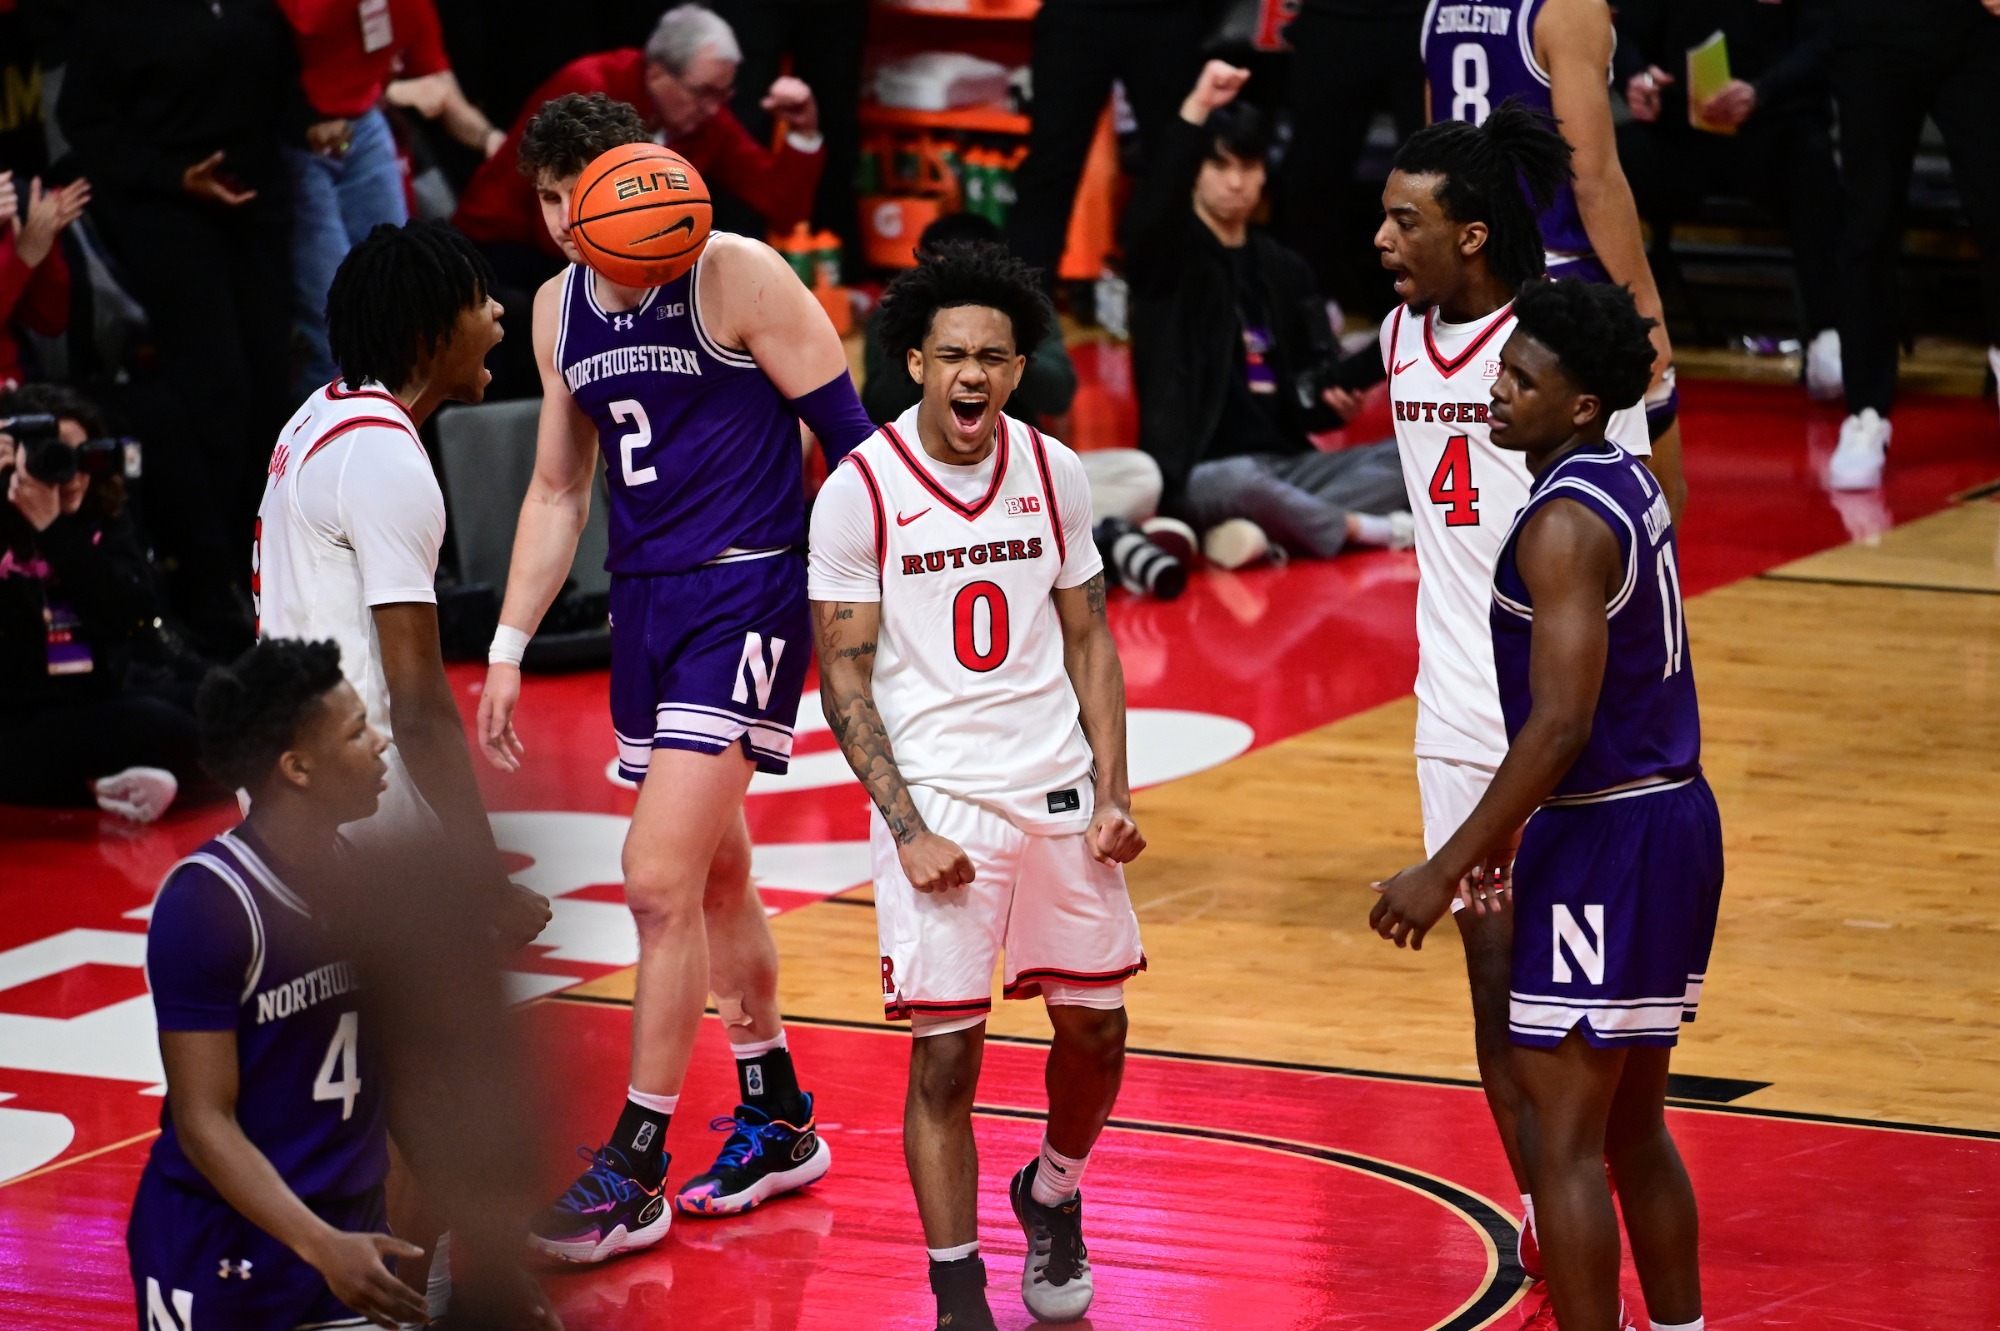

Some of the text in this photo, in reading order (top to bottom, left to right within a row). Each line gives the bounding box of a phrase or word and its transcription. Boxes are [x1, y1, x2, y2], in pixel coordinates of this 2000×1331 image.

[1436, 4, 1512, 35] SINGLETON
[1452, 42, 1491, 128] 8
[614, 172, 690, 201] ELITE
[564, 345, 702, 395] NORTHWESTERN
[608, 399, 658, 486] 2
[1395, 400, 1490, 423] RUTGER
[1429, 434, 1480, 527] 4
[901, 537, 1043, 575] RUTGERS
[953, 580, 1010, 673] 0
[1656, 540, 1683, 682] 11
[731, 631, 786, 711] N
[881, 955, 895, 994] R
[1552, 903, 1605, 985] N
[256, 961, 360, 1024] NORTHW
[313, 1011, 361, 1121] 4
[146, 1276, 194, 1331] N
